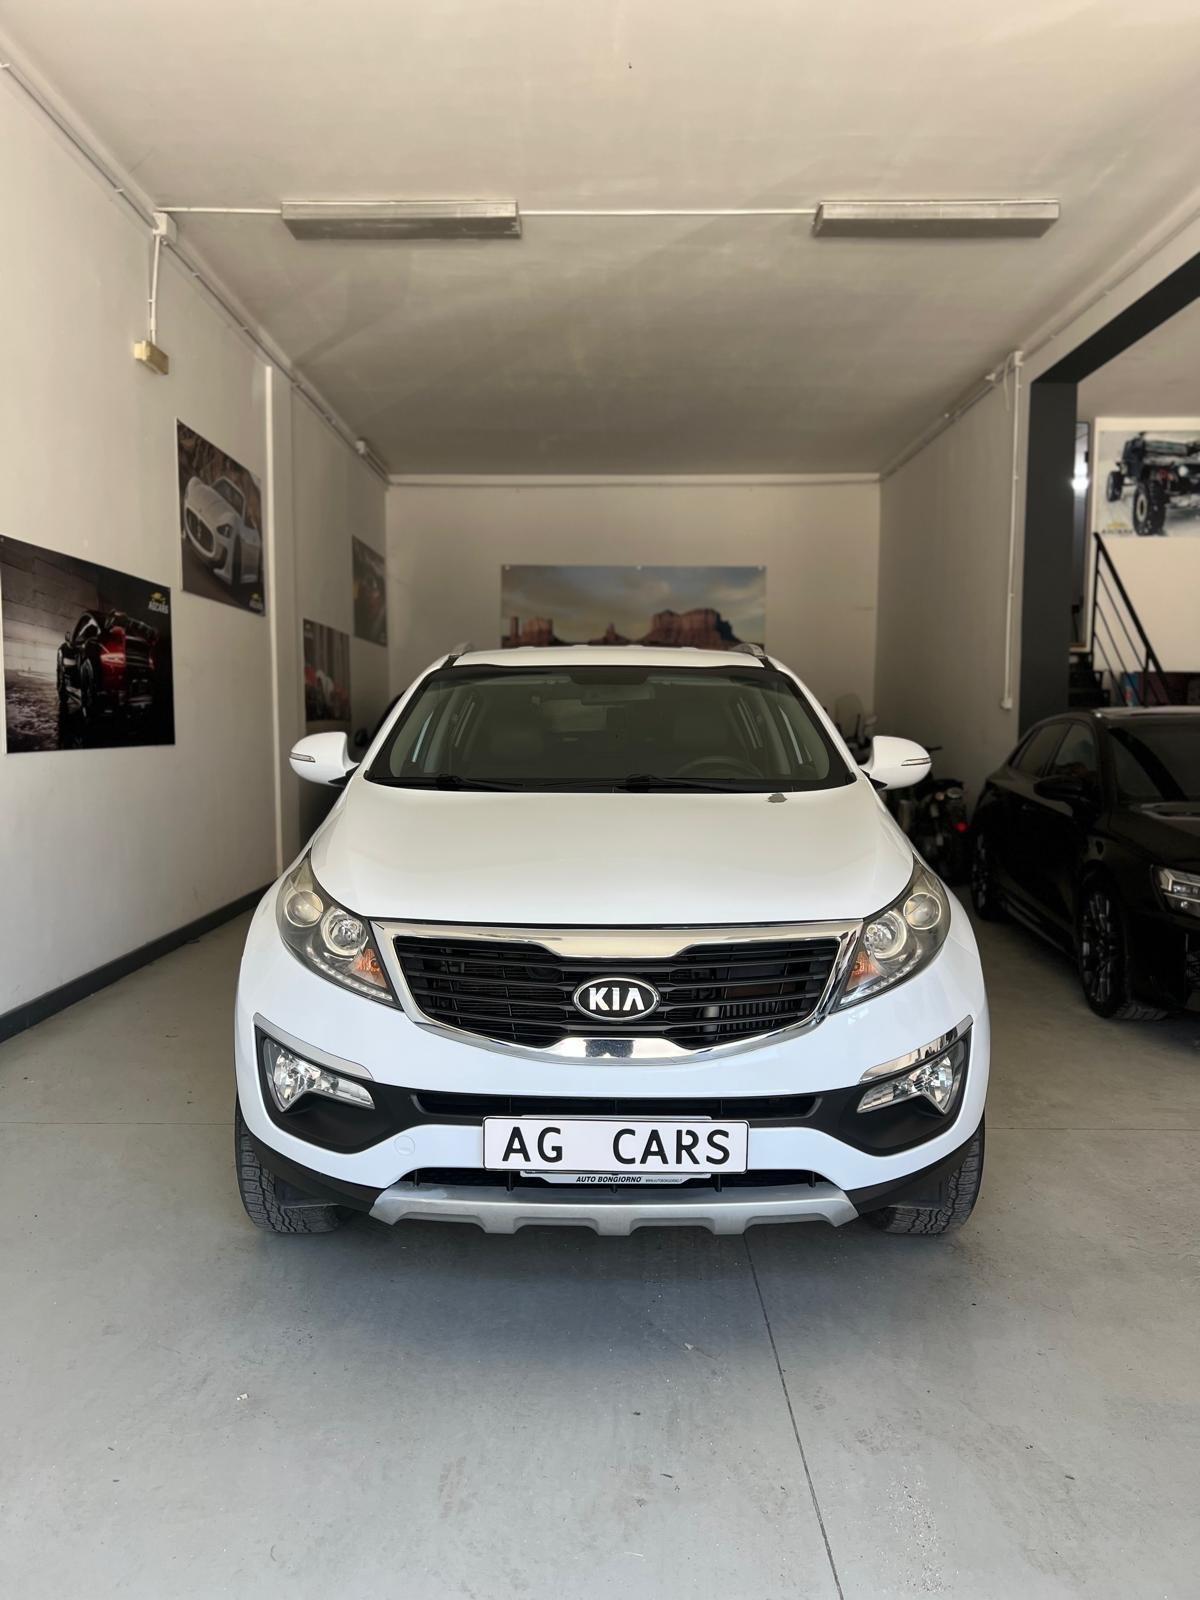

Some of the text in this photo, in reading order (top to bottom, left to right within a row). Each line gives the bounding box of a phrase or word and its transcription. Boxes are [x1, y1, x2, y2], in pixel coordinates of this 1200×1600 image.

[588, 987, 645, 1011] KIA
[502, 1126, 731, 1165] AG CARS
